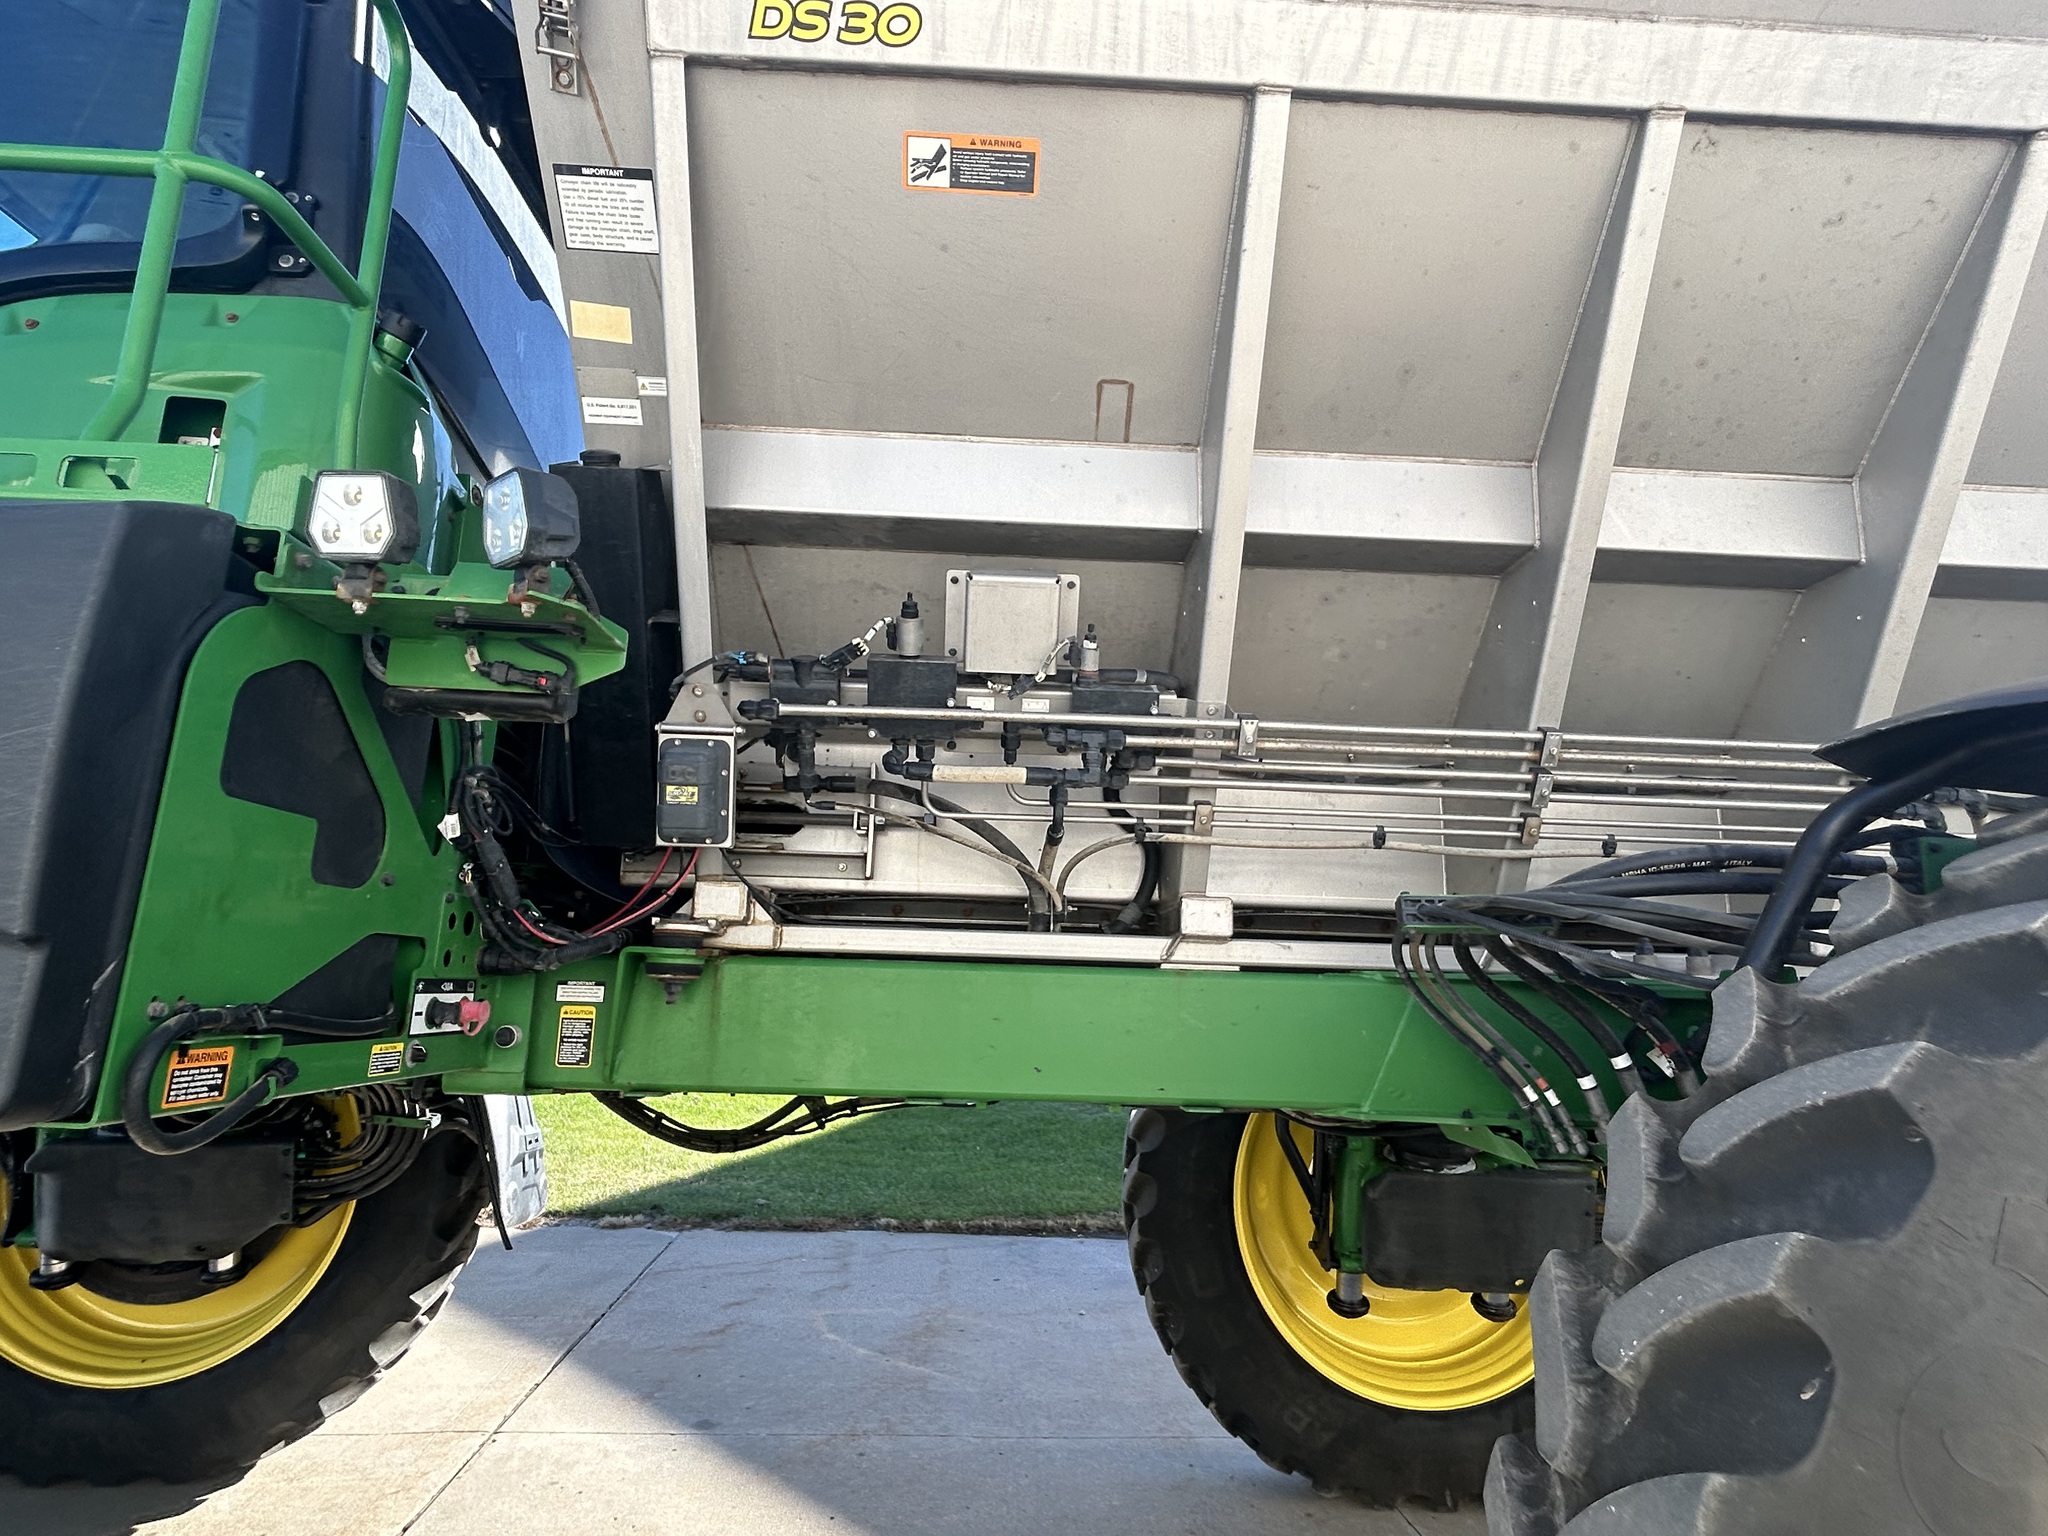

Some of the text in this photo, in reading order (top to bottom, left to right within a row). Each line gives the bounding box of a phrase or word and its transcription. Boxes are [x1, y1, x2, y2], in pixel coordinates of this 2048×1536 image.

[748, 0, 923, 48] DS 30
[979, 138, 1022, 149] WARNING
[581, 167, 624, 177] IMPORTANT
[187, 1051, 228, 1063] WARNING
